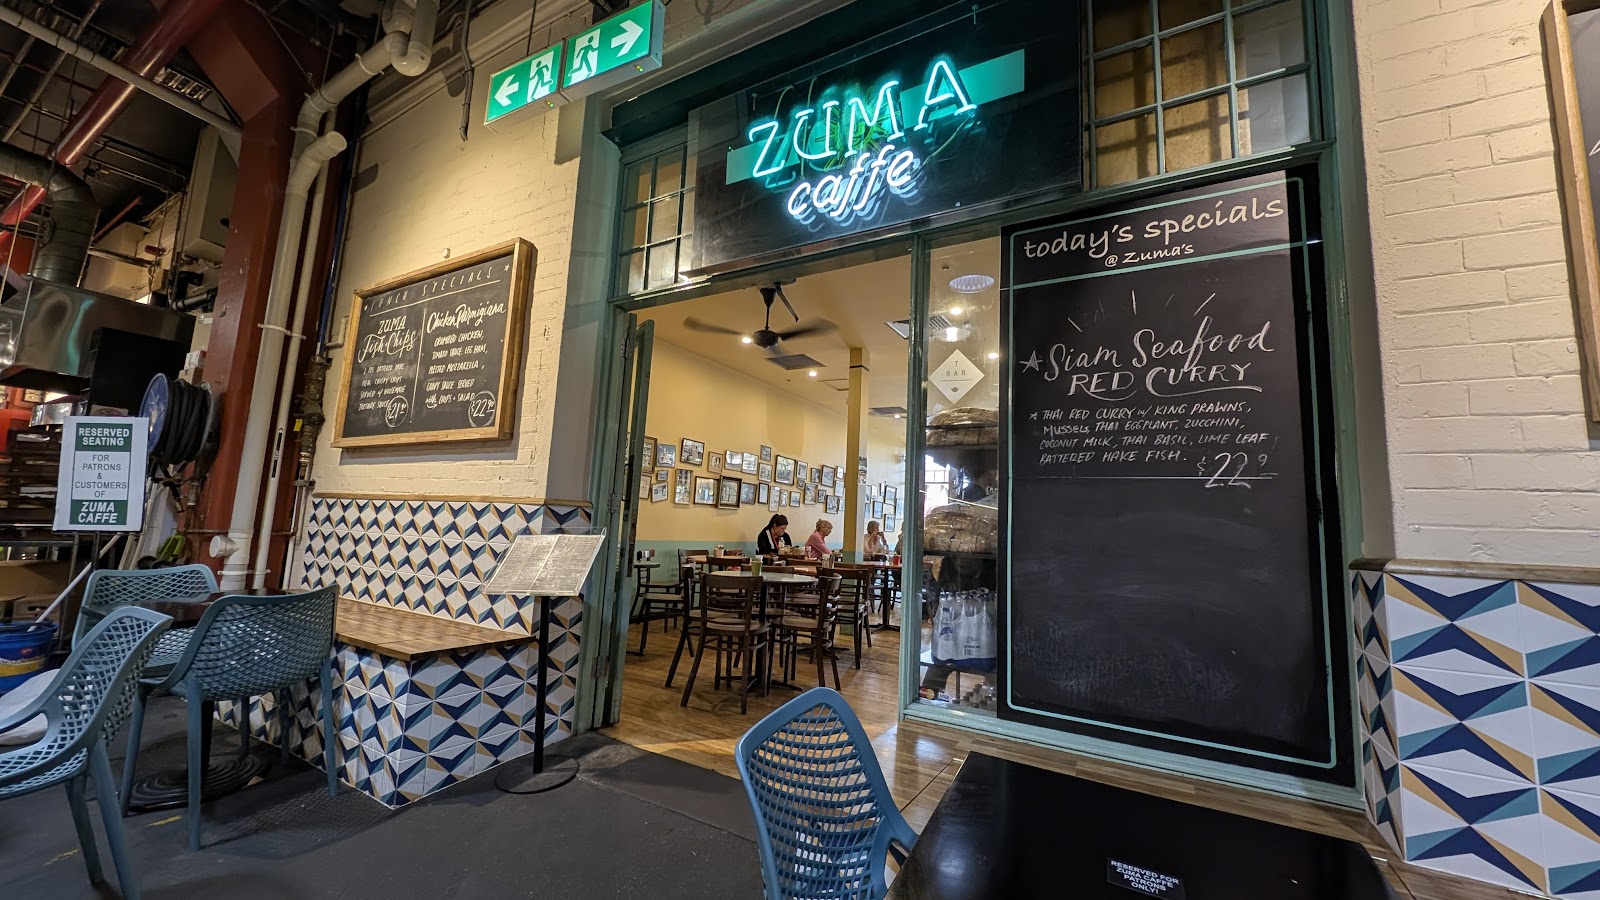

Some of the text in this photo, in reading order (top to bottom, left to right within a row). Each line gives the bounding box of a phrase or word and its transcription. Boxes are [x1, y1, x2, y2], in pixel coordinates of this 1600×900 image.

[749, 60, 978, 178] ZUMA
[788, 144, 914, 218] caffe
[1024, 197, 1285, 258] today's specials
[1104, 244, 1195, 267] @ Zuma's
[422, 266, 492, 296] SPECIALS
[378, 316, 406, 334] ZUMA
[426, 301, 506, 333] Chicken Parmigiana
[358, 334, 386, 363] Fish
[387, 329, 418, 358] Chips
[1044, 316, 1275, 381] Siam Seafood
[1067, 362, 1263, 400] RED CURRY
[1042, 409, 1063, 420] THAI
[1069, 409, 1090, 420] RED
[1096, 407, 1136, 419] CURRY
[1154, 404, 1188, 415] KING
[78, 428, 130, 437] RESERVED
[1095, 422, 1119, 432] THAI
[83, 437, 124, 446] SEATING
[1040, 439, 1078, 450] COCONUT
[1122, 435, 1148, 446] THAI
[1198, 433, 1230, 444] LIME
[1236, 433, 1270, 444] LEAF
[1040, 451, 1095, 466] BATTERED
[1102, 450, 1138, 462] HAKE
[81, 502, 115, 512] ZUMA
[78, 513, 118, 523] CAFFE
[1111, 860, 1179, 885] RESERVED FOR
[1116, 867, 1174, 888] ZUMA CAFFE
[1124, 874, 1166, 891] PATRONS
[1131, 882, 1158, 894] ONLY!
